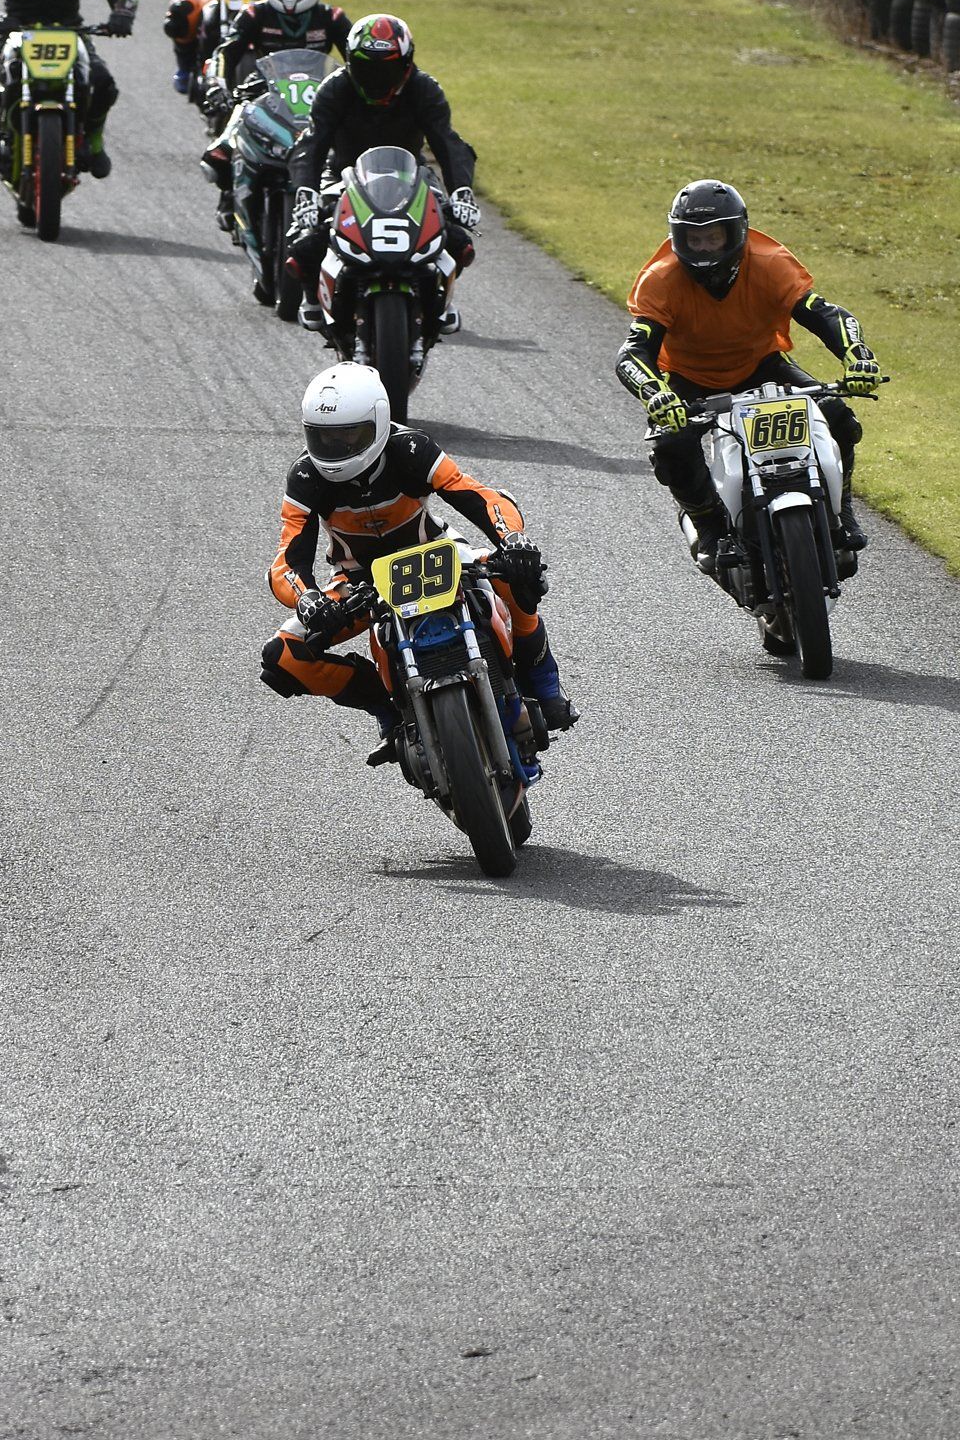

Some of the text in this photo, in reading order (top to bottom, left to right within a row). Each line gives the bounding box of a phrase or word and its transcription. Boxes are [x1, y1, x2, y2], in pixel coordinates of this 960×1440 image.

[30, 44, 70, 60] 383
[288, 83, 317, 105] 16
[372, 218, 410, 253] 5
[751, 409, 807, 449] 666
[390, 544, 455, 607] 89
